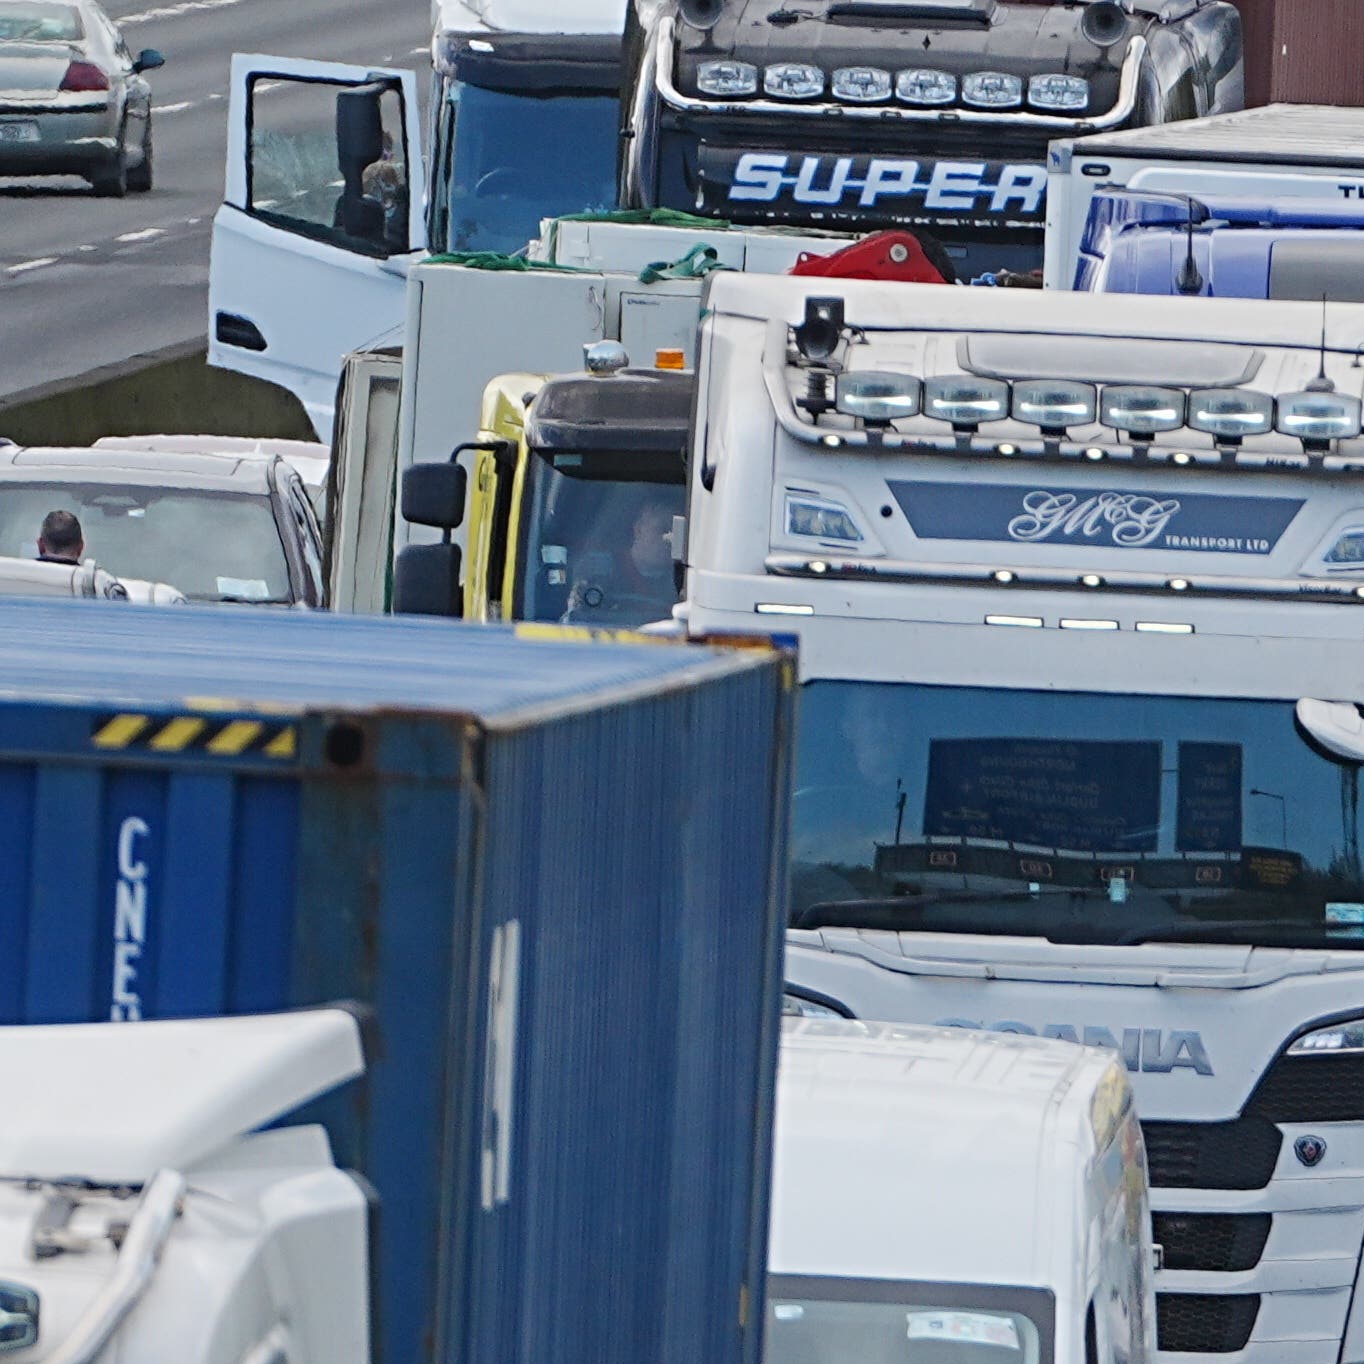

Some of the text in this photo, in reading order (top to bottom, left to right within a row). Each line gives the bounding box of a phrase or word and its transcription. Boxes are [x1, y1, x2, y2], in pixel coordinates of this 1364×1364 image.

[728, 152, 1049, 212] SUPER
[1165, 533, 1269, 551] TRANSPORT LTD
